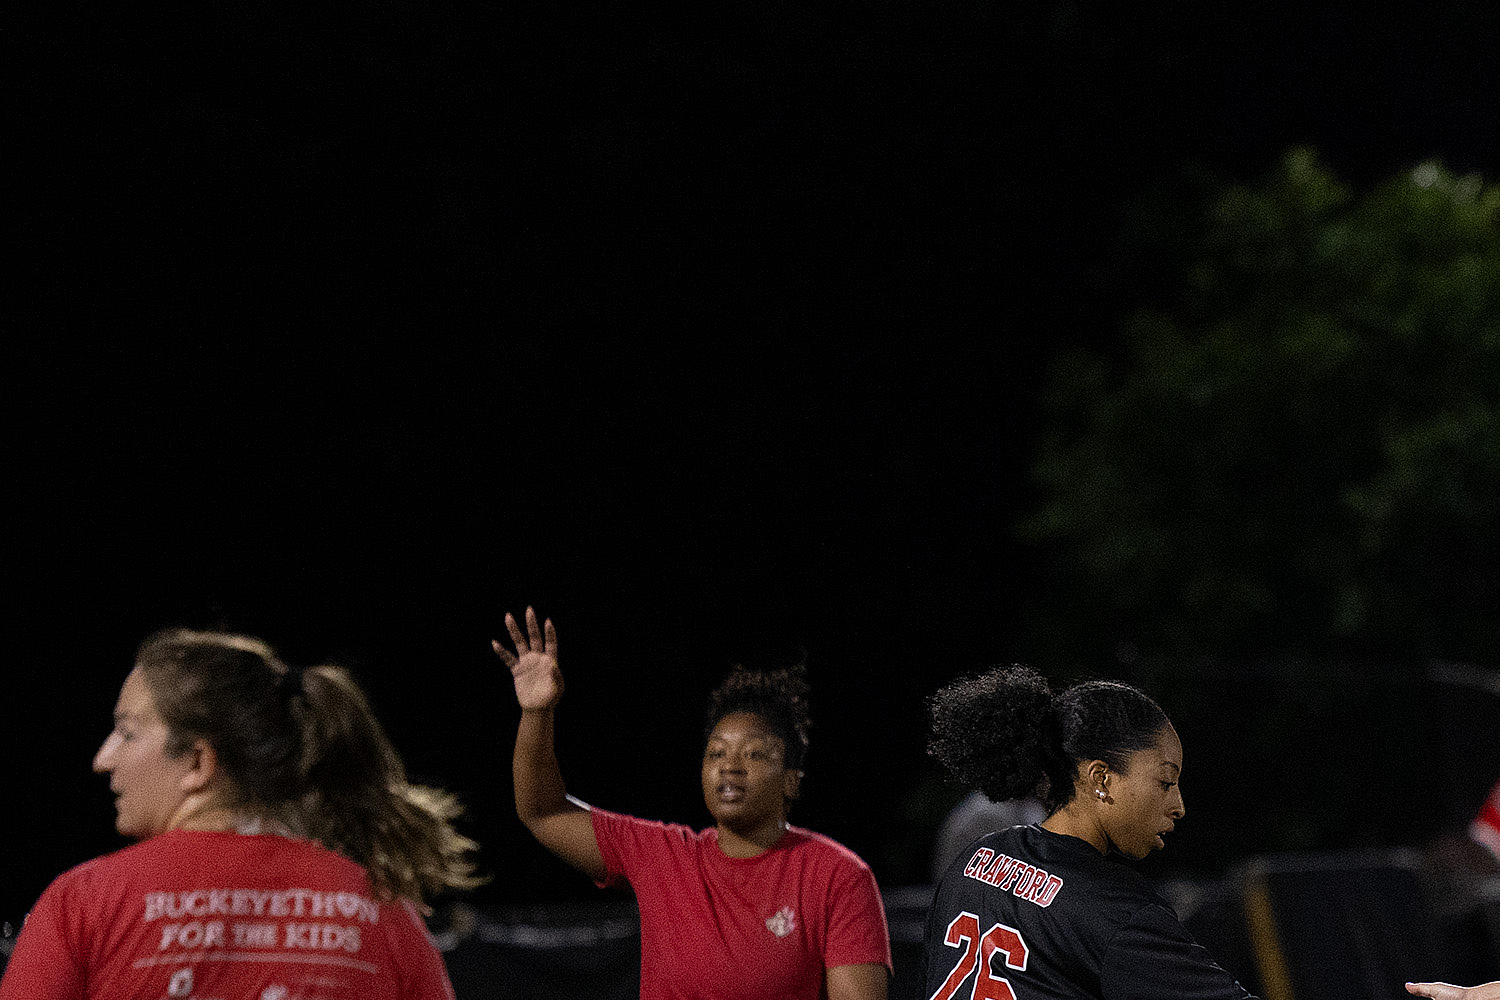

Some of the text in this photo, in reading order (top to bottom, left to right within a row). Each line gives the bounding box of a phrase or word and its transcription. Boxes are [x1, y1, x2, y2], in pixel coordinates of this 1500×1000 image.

[963, 847, 1064, 908] CRAWFORD
[159, 920, 361, 953] FOR THE KIDS
